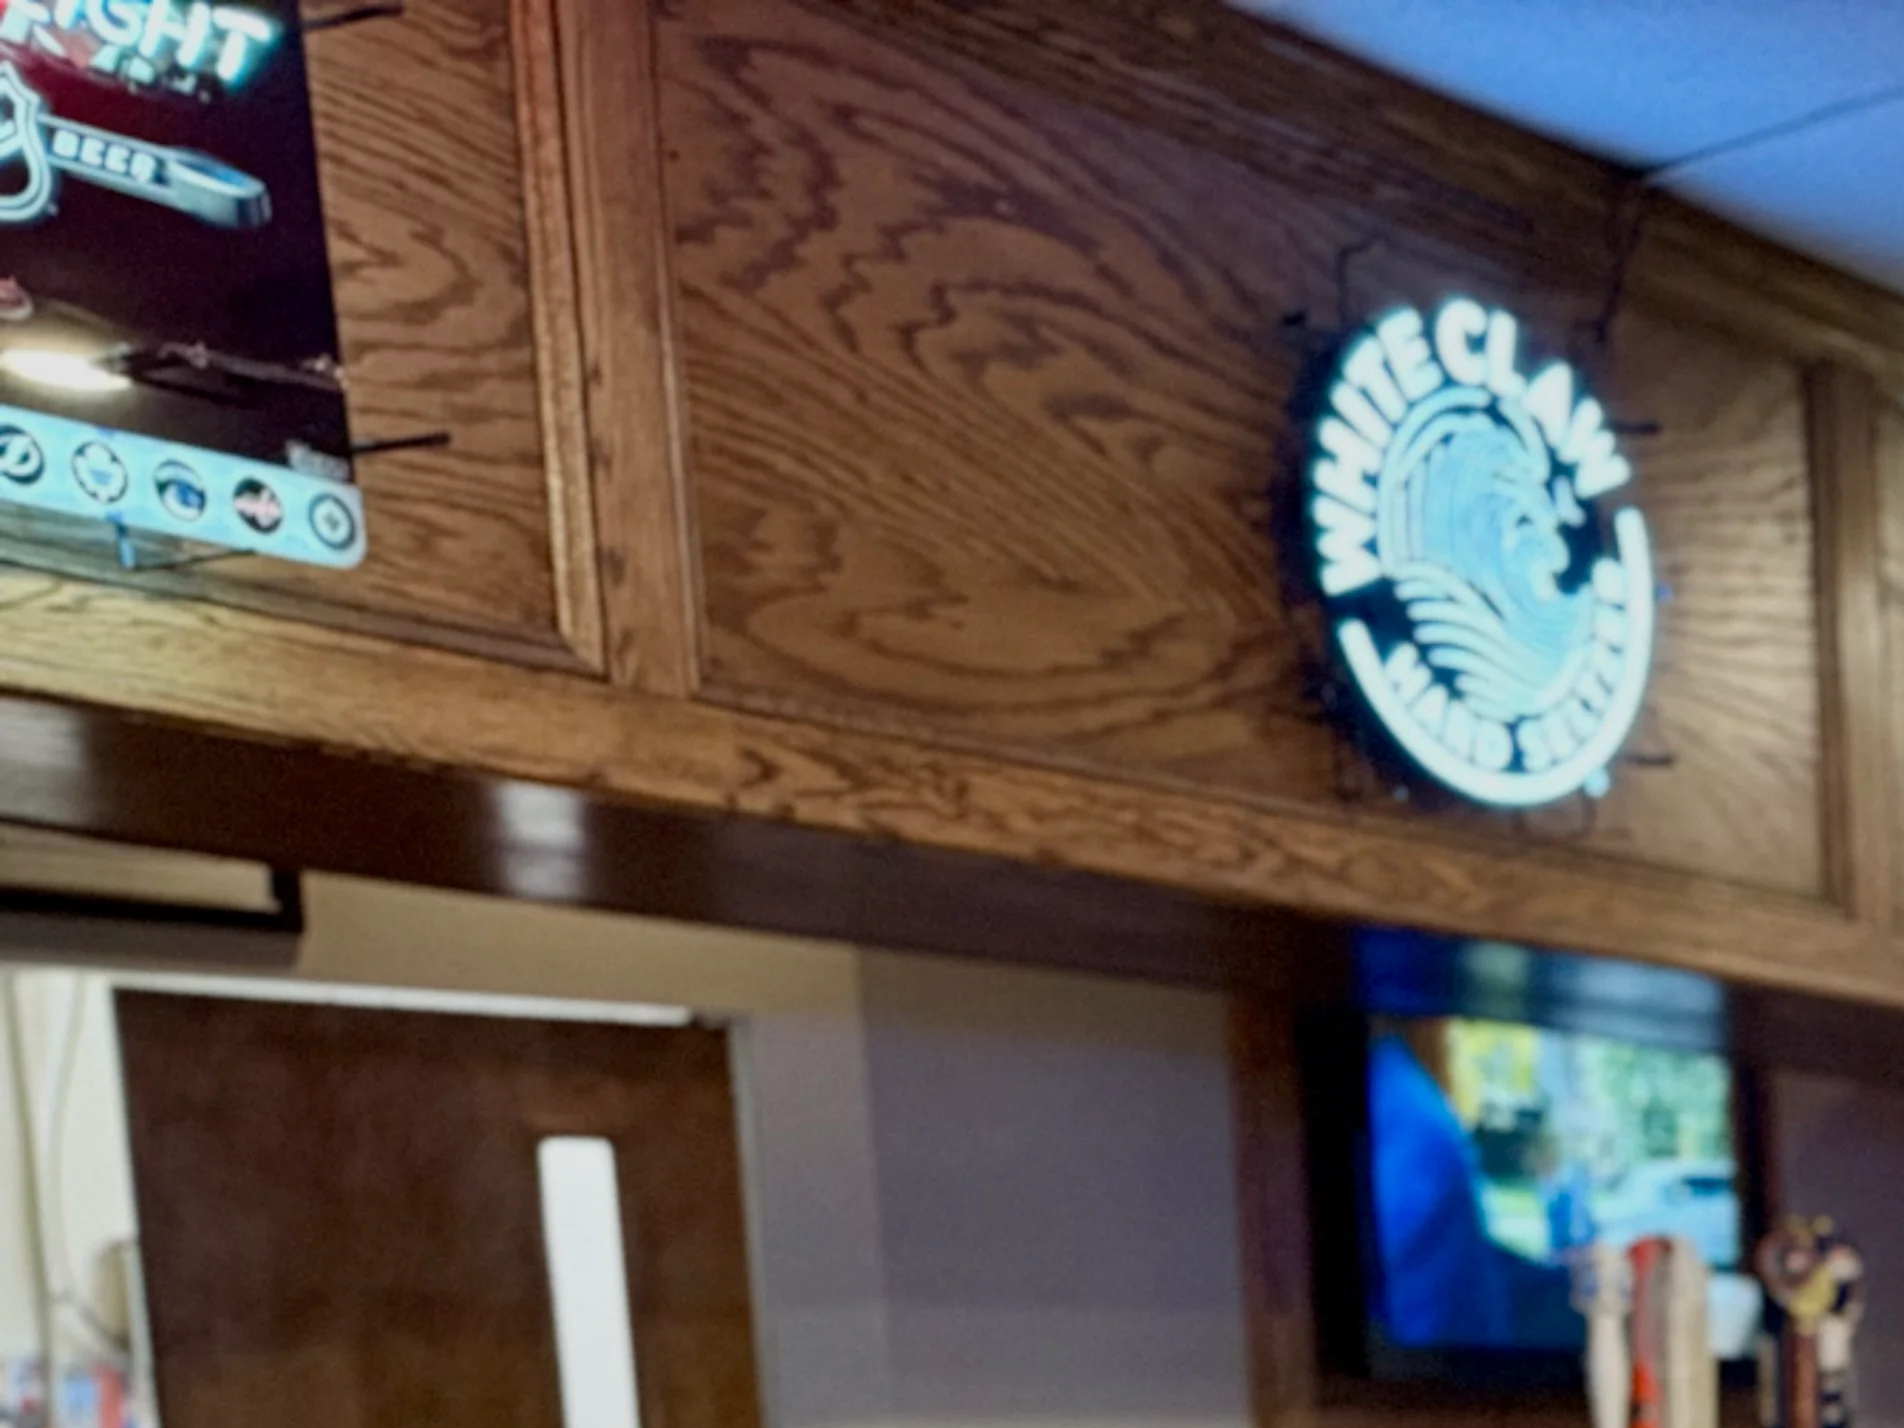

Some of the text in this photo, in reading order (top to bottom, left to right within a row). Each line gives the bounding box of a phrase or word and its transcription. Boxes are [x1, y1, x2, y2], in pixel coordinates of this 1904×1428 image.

[53, 129, 156, 184] BEER
[1313, 299, 1632, 597] WHITE CLAW
